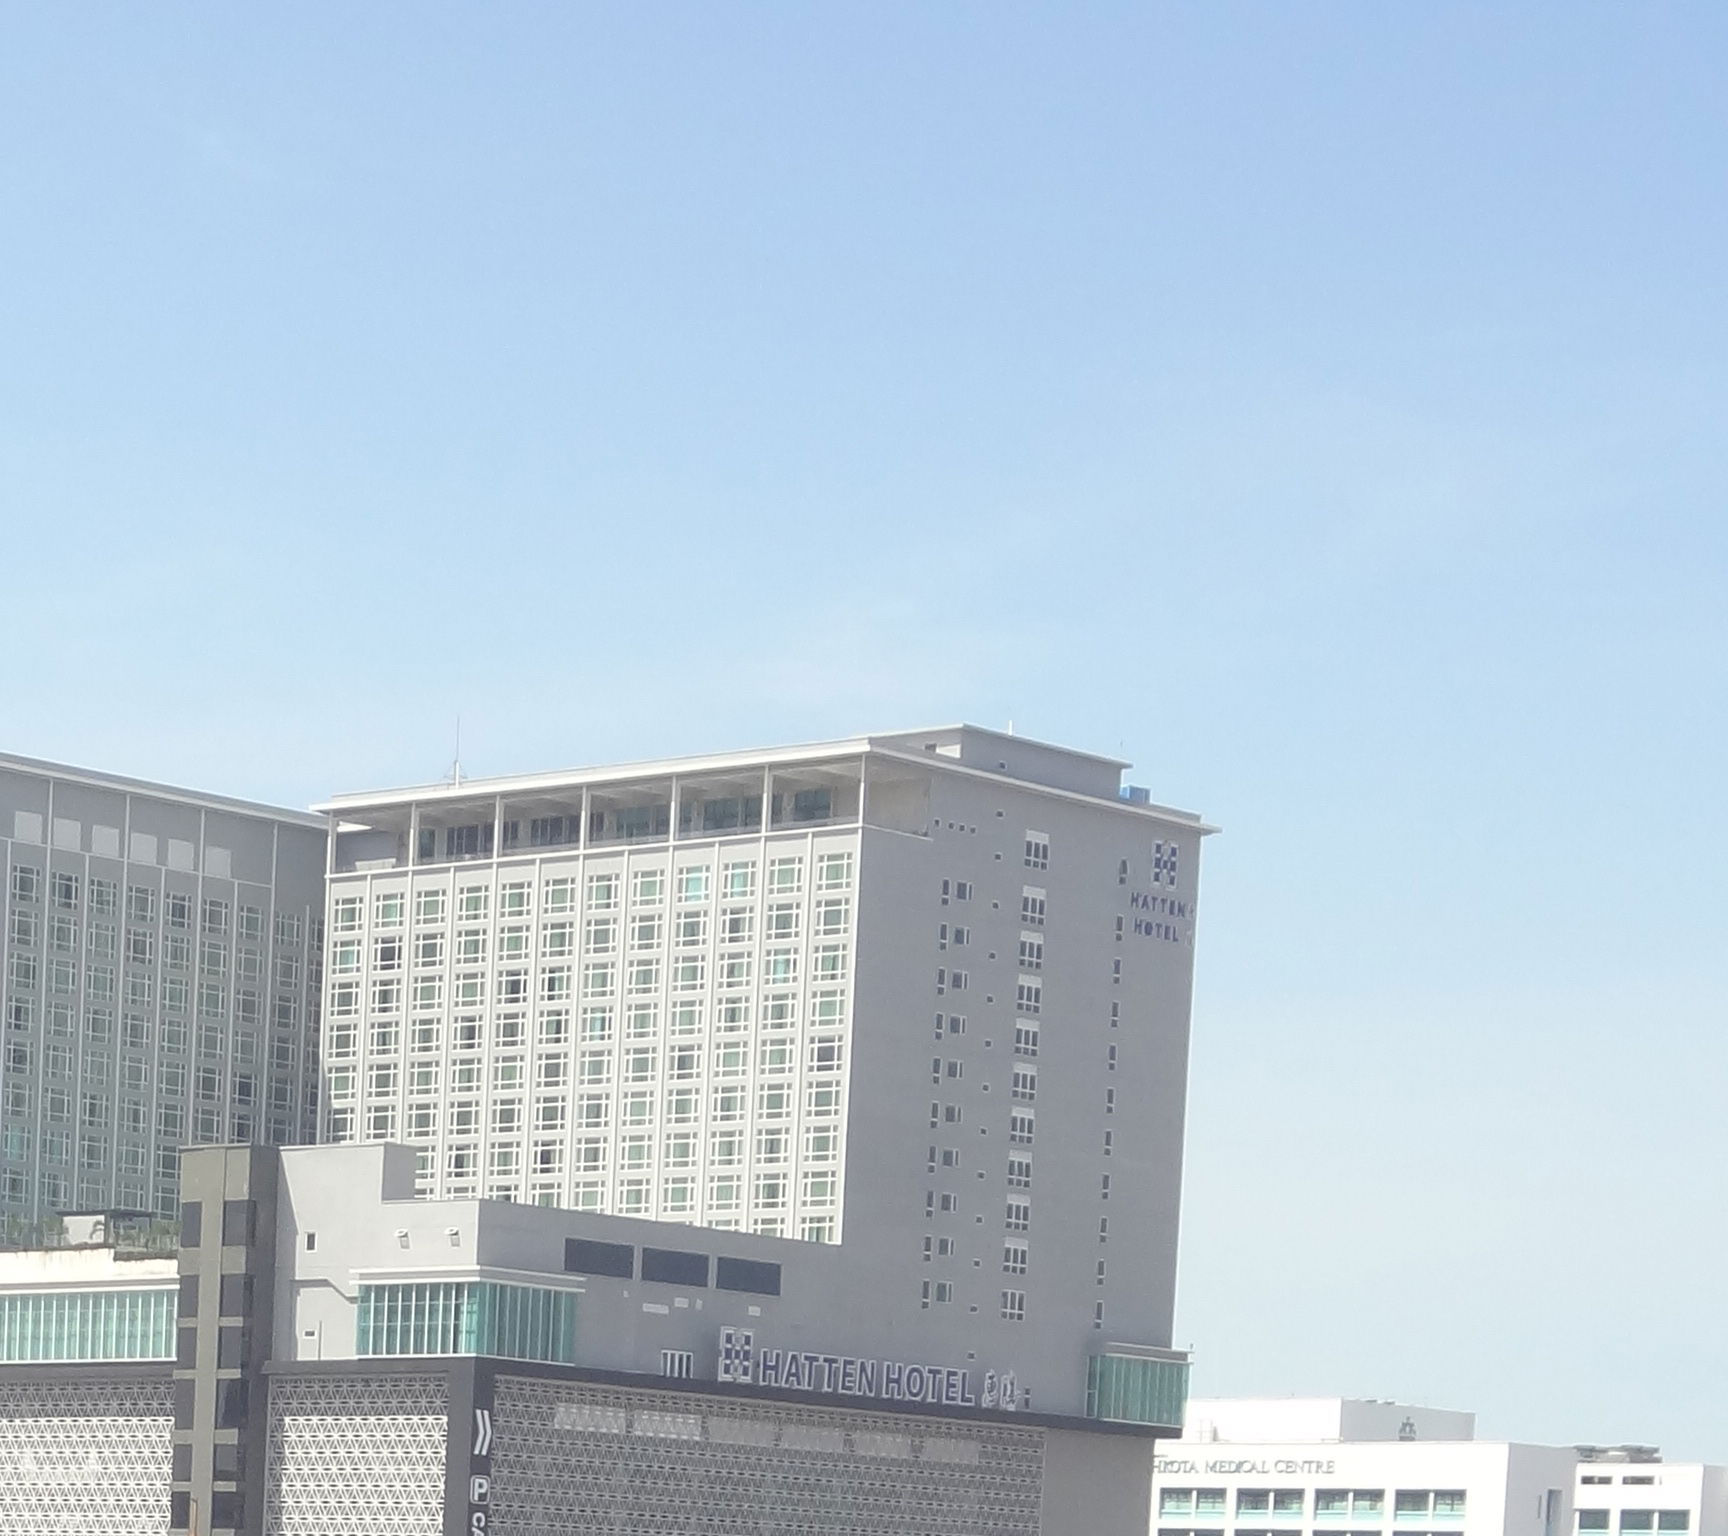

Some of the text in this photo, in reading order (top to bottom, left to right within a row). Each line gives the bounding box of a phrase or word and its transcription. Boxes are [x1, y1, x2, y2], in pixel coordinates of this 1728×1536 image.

[1130, 891, 1186, 918] HATTEN
[1133, 917, 1179, 942] HOTEL
[759, 1349, 877, 1397] HATTEN
[883, 1361, 976, 1407] HOTEL
[1204, 1460, 1270, 1474] MEDICAL
[1273, 1459, 1335, 1474] CENTRE
